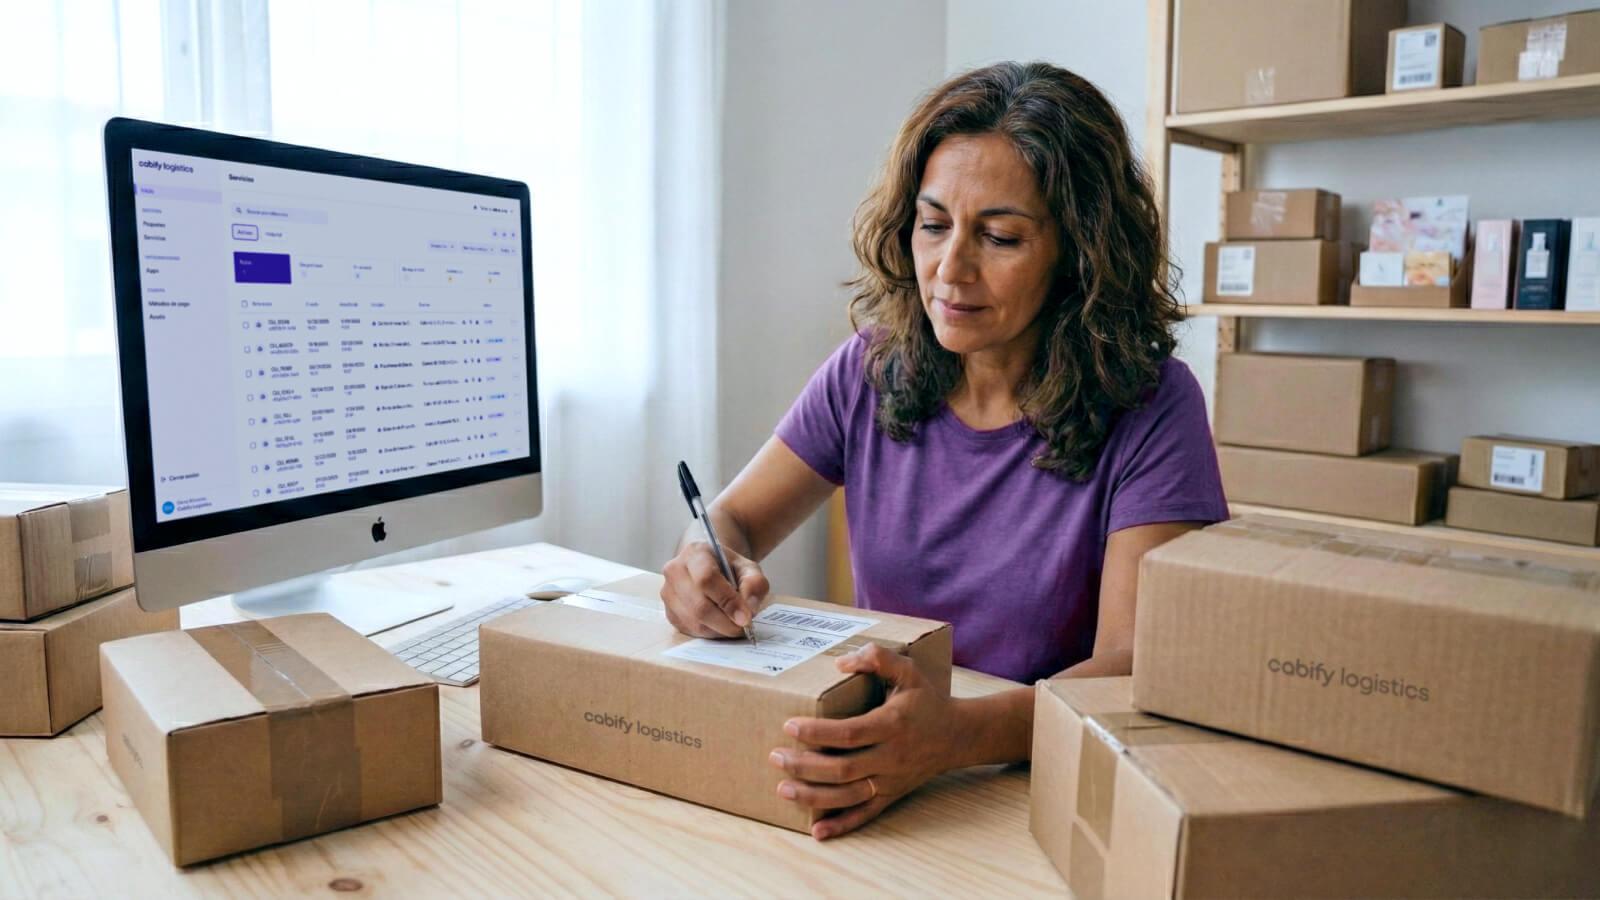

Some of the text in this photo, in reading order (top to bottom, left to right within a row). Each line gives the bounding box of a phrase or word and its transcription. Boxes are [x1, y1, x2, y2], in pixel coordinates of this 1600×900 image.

[138, 160, 194, 174] cabify logistics
[1267, 658, 1430, 702] cabify logistics
[583, 711, 703, 749] cabify logistics
